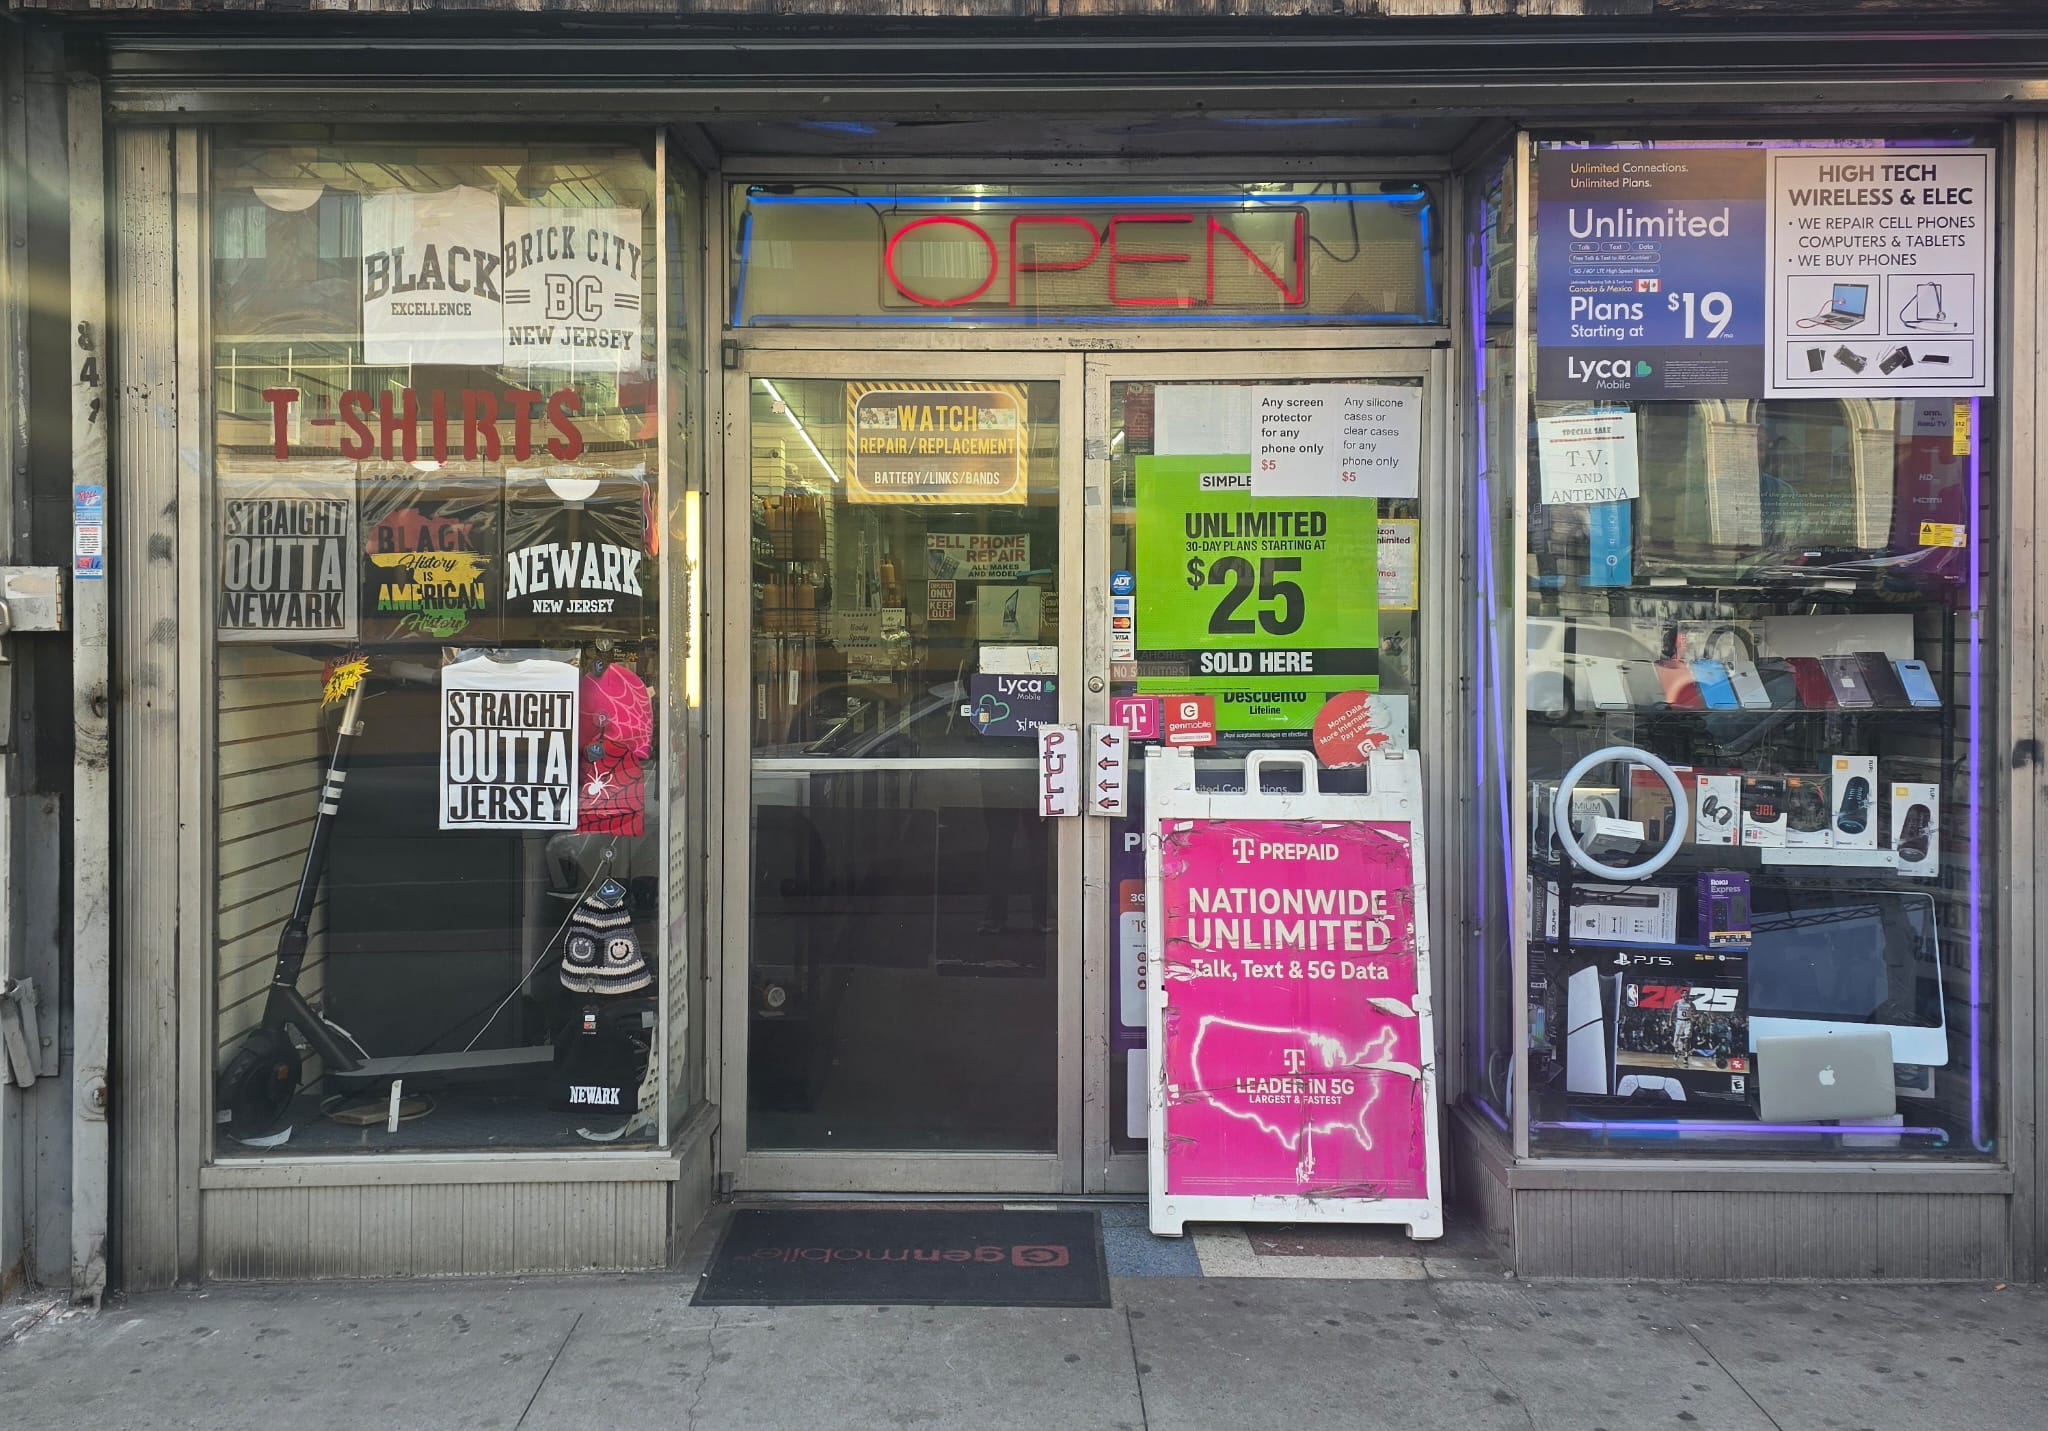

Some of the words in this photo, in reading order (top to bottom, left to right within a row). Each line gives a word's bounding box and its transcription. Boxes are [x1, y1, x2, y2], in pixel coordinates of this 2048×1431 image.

[1570, 163, 1620, 174] Unlimited
[1622, 163, 1689, 174] Connections.
[1819, 164, 1875, 183] HIGH
[1880, 164, 1937, 182] TECH
[1570, 178, 1620, 188] Unlimited
[1622, 178, 1653, 188] Plans.
[1788, 188, 1894, 206] WIRELESS
[1900, 188, 1916, 205] &
[1922, 187, 1974, 205] ELEC
[1569, 207, 1730, 239] Unlimited
[1798, 217, 1821, 229] WE
[1826, 217, 1875, 229] REPAIR
[1879, 216, 1913, 229] CELL
[1917, 216, 1976, 229] PHONES
[1608, 243, 1622, 251] Text
[1798, 235, 1887, 248] COMPUTERS
[1891, 235, 1901, 247] &
[1905, 235, 1966, 247] TABLETS
[504, 225, 577, 278] BRICK
[586, 228, 642, 281] CITY
[885, 214, 1304, 309] OPEN
[1798, 255, 1821, 267] WE
[1826, 255, 1854, 267] BUY
[1858, 254, 1917, 266] PHONES
[364, 243, 501, 303] BLACK
[1569, 285, 1598, 293] Canada
[1599, 285, 1605, 293] &
[1606, 285, 1633, 293] Mexico
[544, 273, 603, 322] BC
[390, 302, 472, 317] EXCELLENCE
[1570, 296, 1644, 321] Plans
[1667, 291, 1733, 339] $19
[508, 325, 556, 346] NEW
[560, 326, 634, 350] JERSEY
[1570, 325, 1625, 341] Starting
[1629, 326, 1644, 338] at
[1568, 356, 1632, 383] Lyca
[1596, 379, 1632, 390] Mobile
[1261, 397, 1284, 409] Any
[1286, 397, 1324, 408] screen
[1344, 397, 1364, 409] Any
[1366, 397, 1404, 408] silicone
[897, 404, 979, 432] WATCH
[1261, 412, 1313, 424] protector
[1343, 412, 1373, 422] cases
[1375, 413, 1386, 422] or
[262, 387, 586, 463] T-SHIRTS
[1343, 426, 1368, 437] clear
[1370, 427, 1400, 437] cases
[1261, 427, 1276, 437] for
[1279, 428, 1300, 440] any
[1261, 443, 1297, 456] phone
[1298, 443, 1324, 456] only
[1343, 440, 1357, 451] for
[1358, 441, 1377, 453] any
[1261, 459, 1277, 472] $5
[1342, 456, 1374, 469] phone
[1375, 456, 1400, 469] only
[1565, 449, 1609, 468] T.V.
[1202, 475, 1252, 488] SIMPLE
[1341, 471, 1357, 483] $5
[1574, 472, 1604, 484] AND
[1551, 487, 1630, 503] ANTENNA
[226, 500, 347, 537] STRAIGHT
[1185, 511, 1327, 539] UNLIMITED
[377, 524, 474, 554] BLACK
[1376, 528, 1396, 536] izon
[926, 535, 966, 550] CELL
[969, 535, 1026, 550] PHONE
[1185, 541, 1222, 551] 30-DAY
[1223, 541, 1258, 551] PLANS
[1261, 540, 1313, 551] STARTING
[1312, 540, 1326, 550] AT
[1376, 535, 1411, 546] nlimited
[397, 553, 459, 571] History
[966, 549, 1027, 563] REPAIR
[224, 537, 344, 591] OUTTA
[505, 541, 644, 601] NEWARK
[971, 563, 988, 571] ALL
[990, 563, 1020, 571] MAKES
[423, 571, 434, 582] IS
[968, 570, 987, 578] AND
[1113, 576, 1133, 587] ADT
[377, 582, 486, 611] AMERICAN
[930, 589, 953, 598] ONLY
[1186, 555, 1306, 636] $25
[220, 592, 343, 628] NEWARK
[532, 599, 563, 613] NEW
[566, 599, 615, 613] JERSEY
[929, 601, 954, 610] KEEP
[931, 610, 951, 618] OUT
[399, 612, 470, 636] History
[1200, 651, 1253, 674] SOLD
[1259, 651, 1314, 673] HERE
[1113, 666, 1128, 679] NO
[998, 676, 1042, 696] Lyca
[1016, 693, 1042, 701] Mobile
[449, 691, 571, 728] STRAIGHT
[1249, 706, 1281, 715] Lifeline
[1327, 713, 1347, 730] More
[1345, 704, 1363, 719] Data
[1168, 720, 1213, 732] genmobile
[1319, 730, 1339, 745] More
[1339, 730, 1355, 742] Pay
[449, 728, 569, 785] OUTTA
[1043, 731, 1067, 816] PULL
[449, 785, 569, 822] JERSEY
[1573, 801, 1601, 811] MIUM
[1755, 804, 1776, 817] JBL
[1259, 843, 1340, 861] PREPAID
[1710, 886, 1742, 894] Express
[1188, 887, 1388, 916] NATIONWIDE
[1187, 917, 1391, 952] UNLIMITED
[1633, 955, 1673, 966] PS5
[1191, 959, 1238, 982] Talk,
[1241, 959, 1284, 978] Text
[1289, 960, 1304, 979] &
[1308, 960, 1336, 979] 5G
[1341, 961, 1389, 980] Data
[1236, 1077, 1304, 1095] LEADER
[1331, 1078, 1355, 1095] 5G
[569, 1085, 620, 1106] NEWARK
[1249, 1094, 1292, 1105] LARGEST
[1294, 1095, 1301, 1105] &
[1303, 1095, 1343, 1105] FASTEST
[752, 1245, 1006, 1266] genmobile
